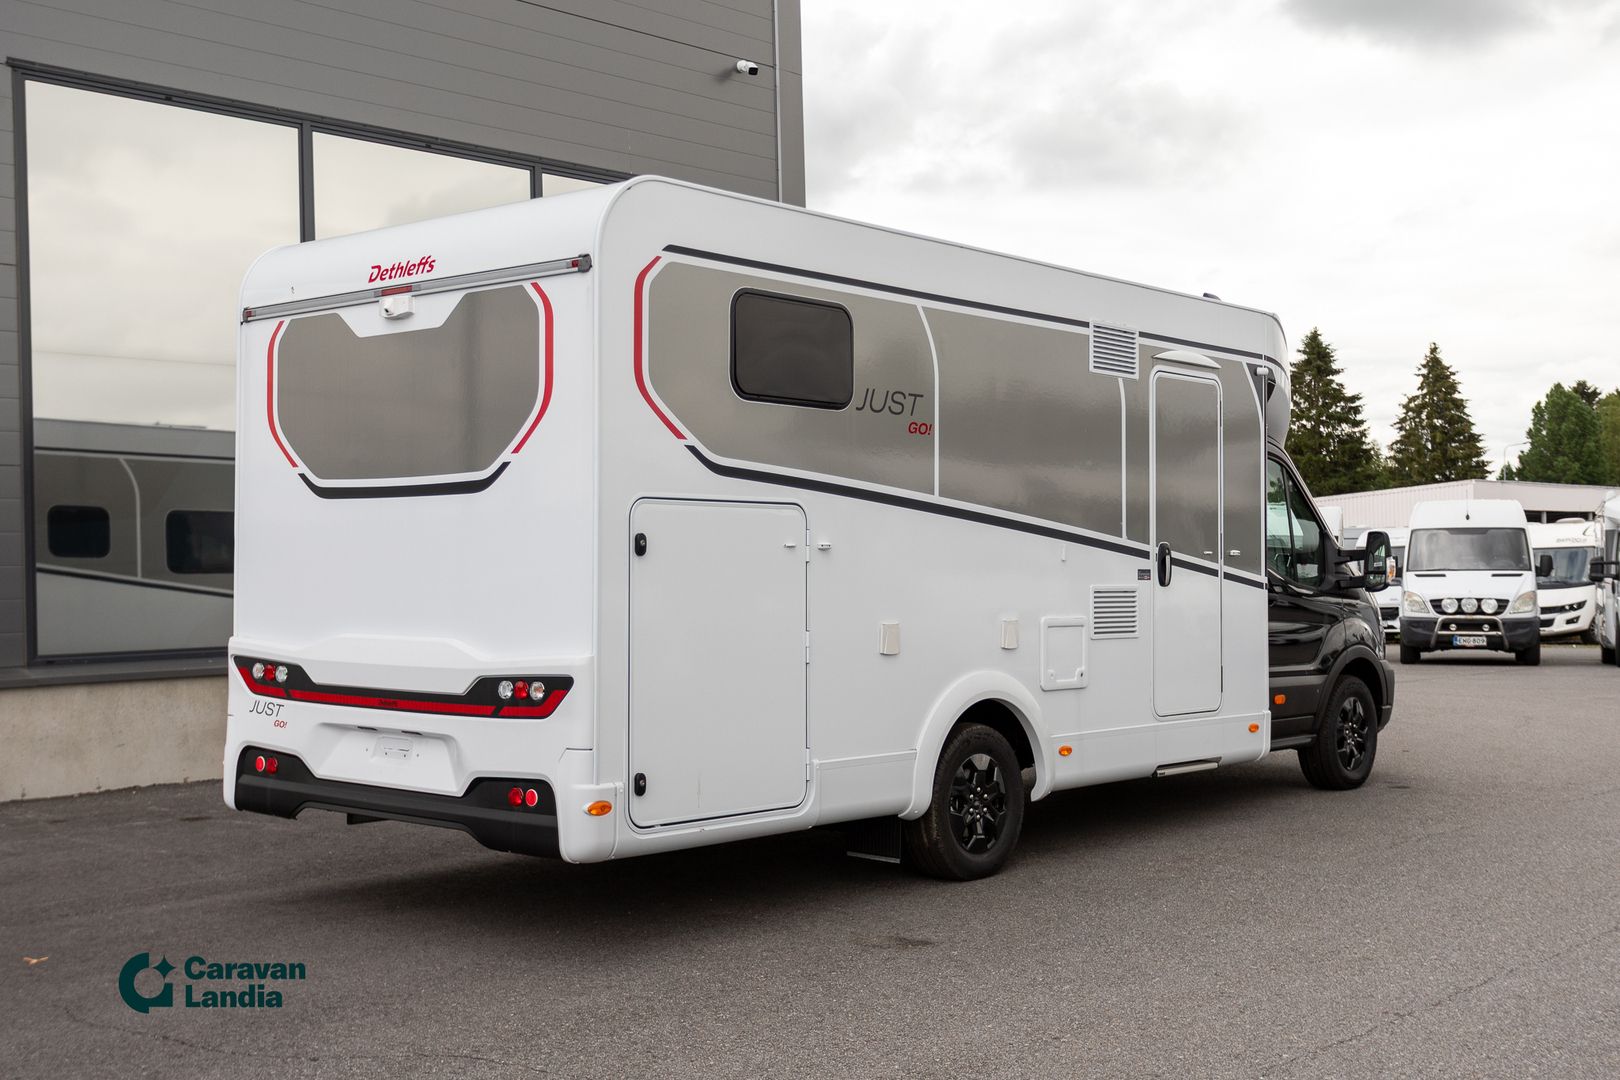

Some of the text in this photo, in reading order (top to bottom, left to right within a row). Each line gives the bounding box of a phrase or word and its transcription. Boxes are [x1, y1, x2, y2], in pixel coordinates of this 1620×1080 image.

[368, 255, 436, 283] Dethleffs
[856, 388, 924, 416] JUST
[908, 421, 933, 436] GO!
[249, 700, 285, 717] JUST
[273, 719, 288, 729] GO!
